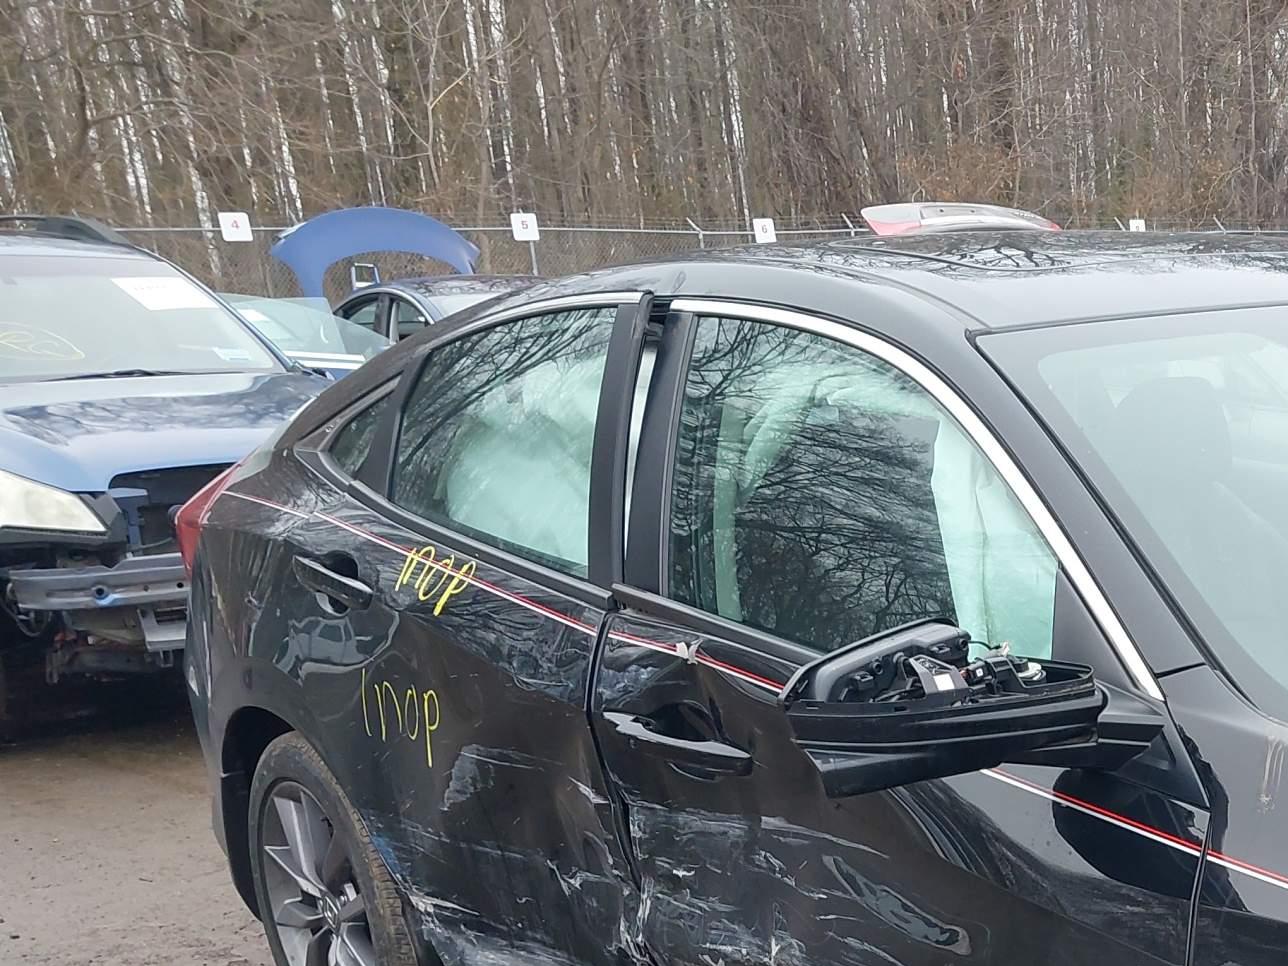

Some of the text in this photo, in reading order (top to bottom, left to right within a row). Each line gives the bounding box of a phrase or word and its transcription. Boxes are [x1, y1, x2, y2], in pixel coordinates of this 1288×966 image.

[231, 219, 240, 230] 4
[520, 220, 529, 230] 5
[761, 224, 768, 234] 6
